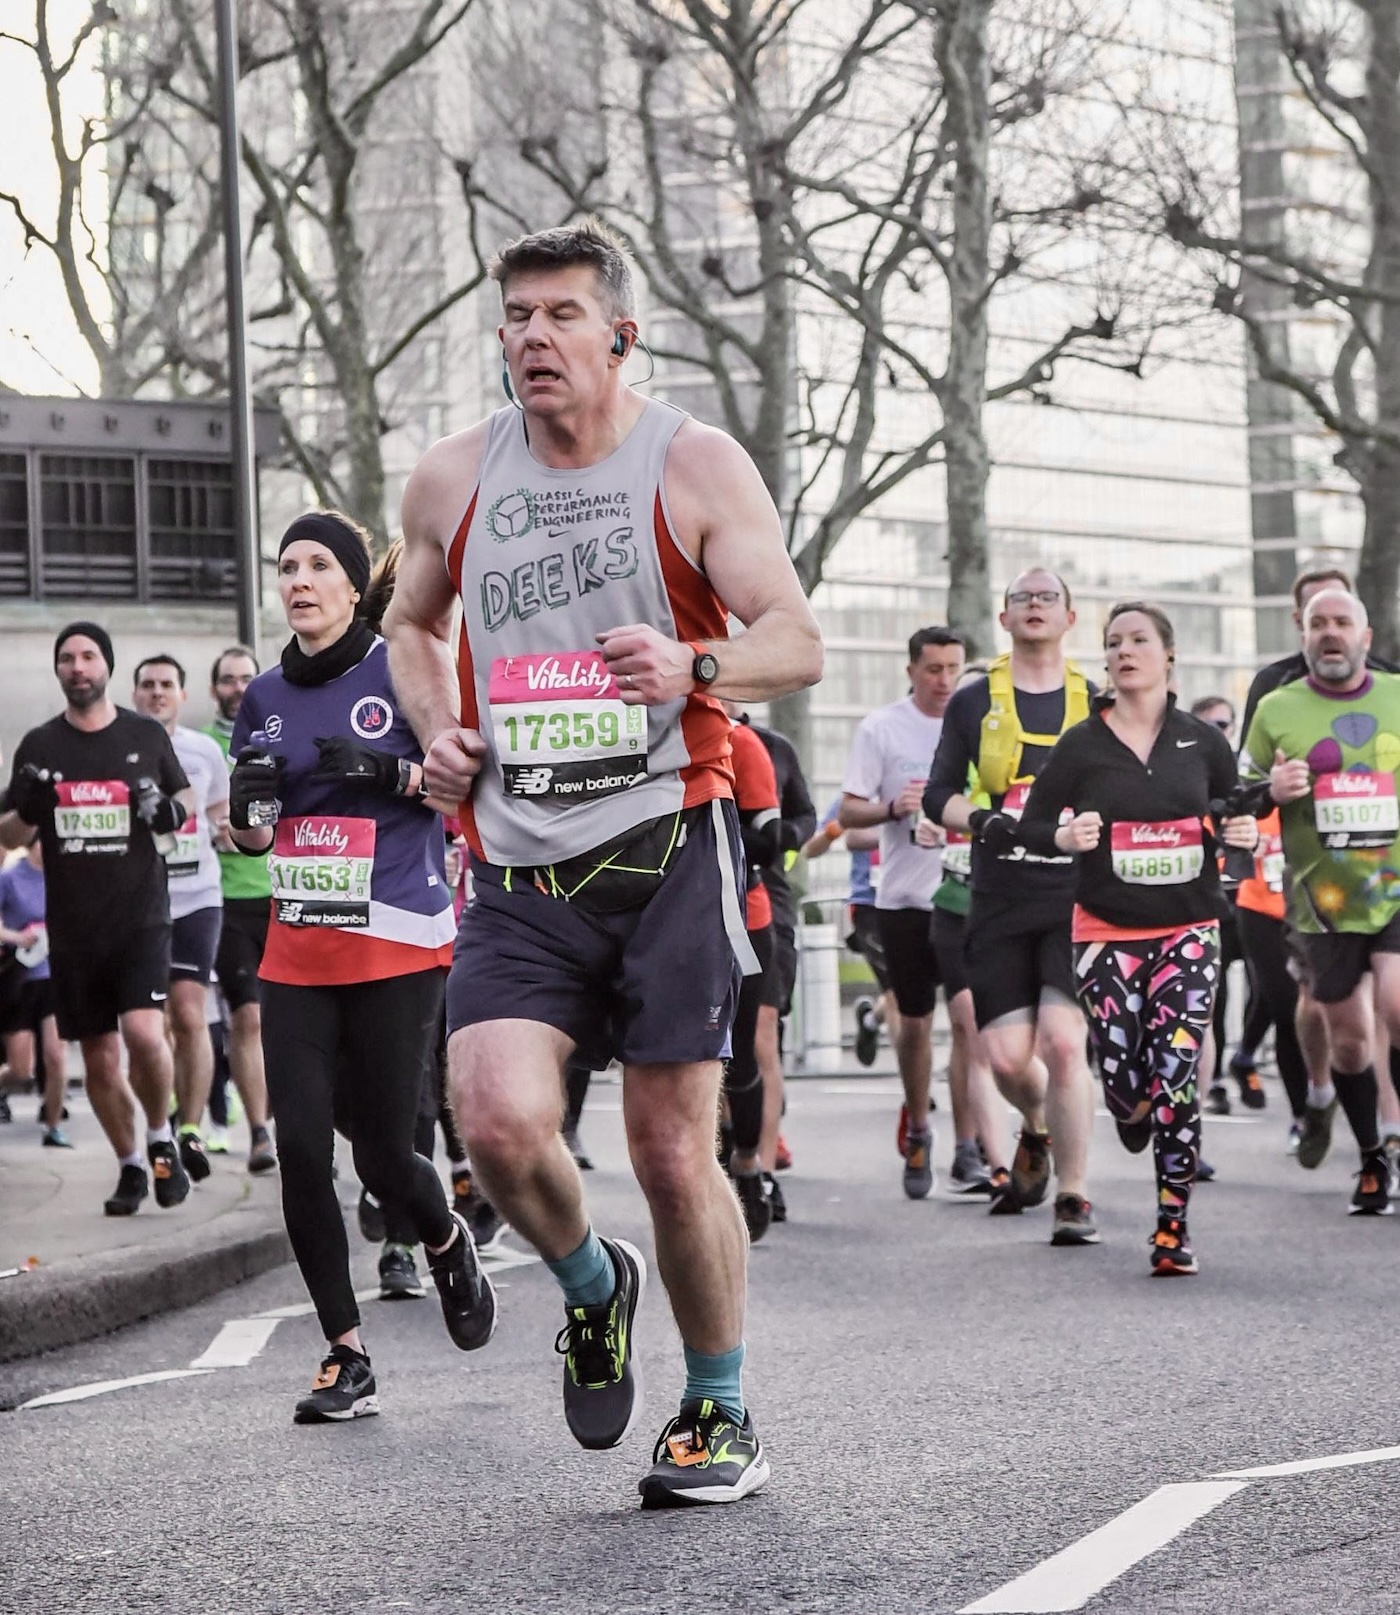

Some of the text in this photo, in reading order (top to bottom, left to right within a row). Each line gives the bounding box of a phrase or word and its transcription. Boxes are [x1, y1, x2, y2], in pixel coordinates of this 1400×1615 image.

[534, 488, 585, 501] CLASSIC
[534, 492, 630, 516] PERFORMANCE
[534, 507, 630, 529] ENGINEERING
[481, 527, 639, 633] DEEKS
[527, 657, 611, 696] Vitality
[503, 711, 619, 751] 17359
[629, 739, 638, 750] 9
[554, 781, 583, 794] new
[586, 774, 635, 790] balanc
[62, 813, 116, 831] 17430
[1322, 805, 1381, 824] 15107
[294, 819, 349, 854] Vitality
[273, 863, 351, 892] 17553
[1118, 855, 1183, 878] 15851
[302, 914, 322, 923] new
